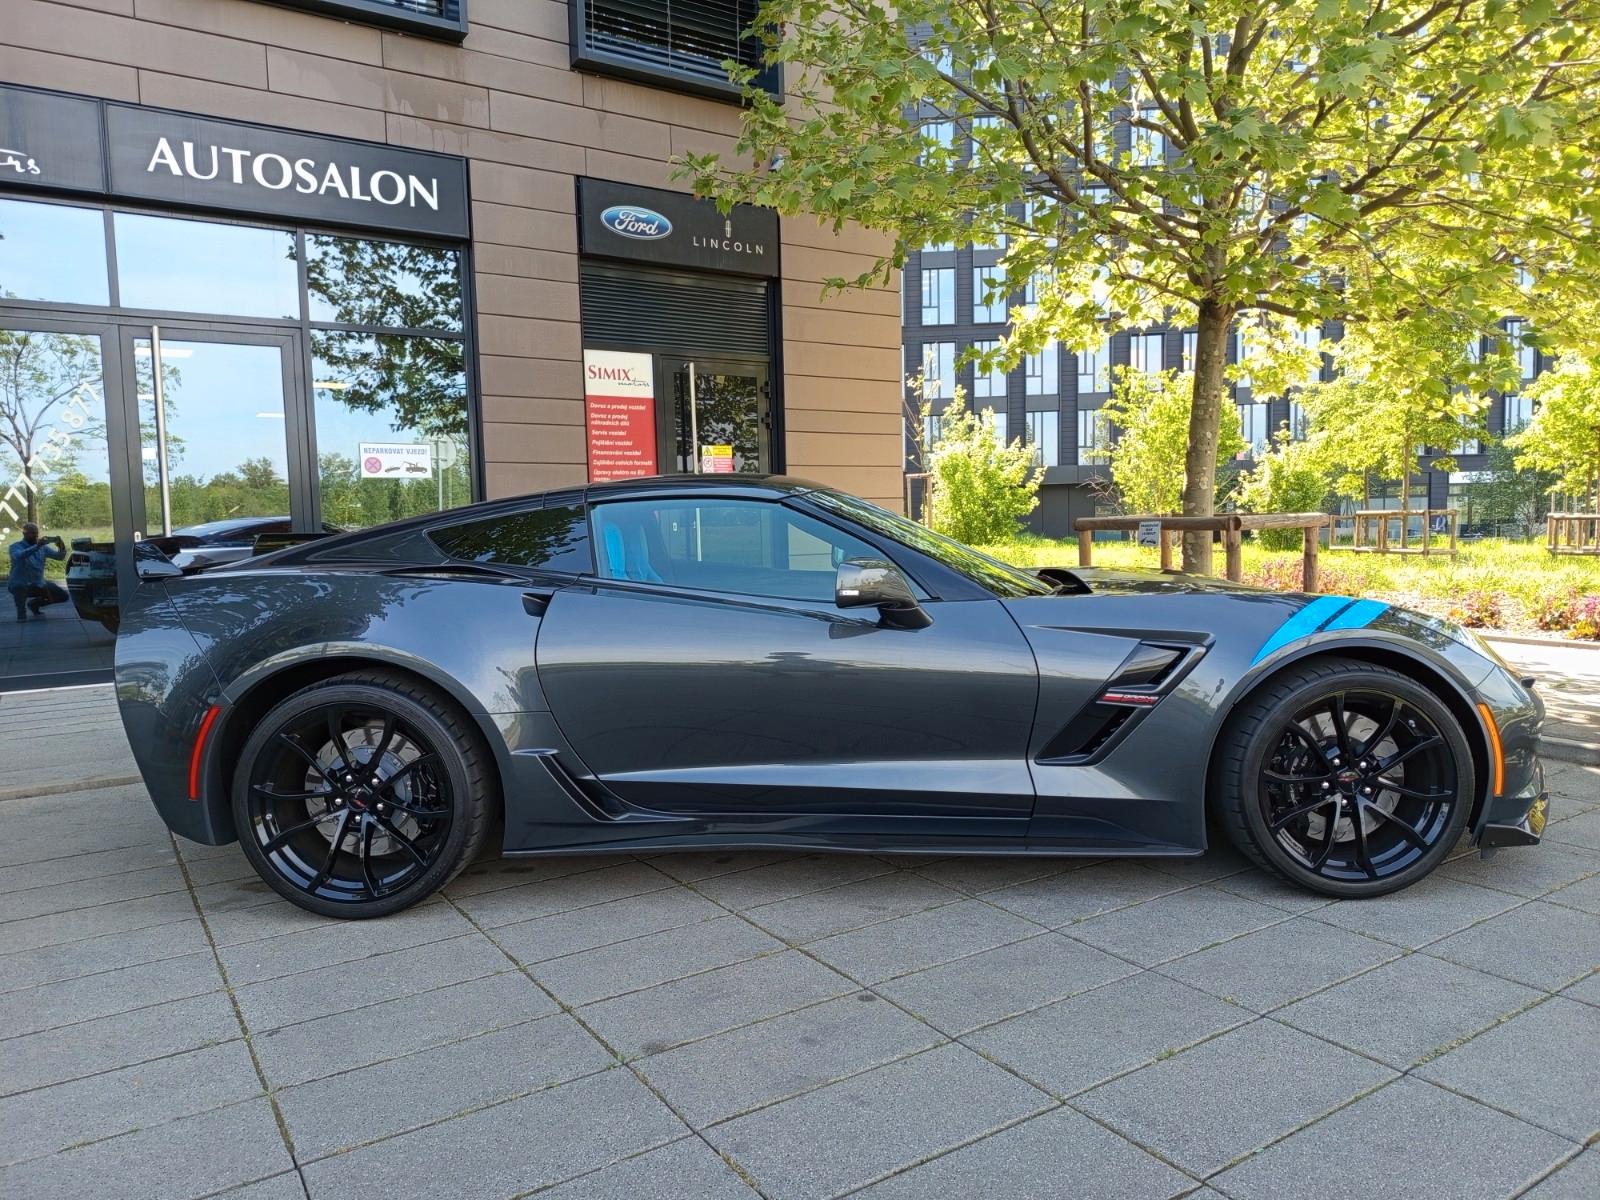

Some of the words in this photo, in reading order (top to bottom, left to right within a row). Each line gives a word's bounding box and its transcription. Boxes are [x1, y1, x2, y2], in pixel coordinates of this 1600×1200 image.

[147, 137, 439, 211] AUTOSALON
[614, 210, 659, 236] Ford
[693, 236, 764, 255] LINCOLN
[588, 365, 631, 381] SIMIX
